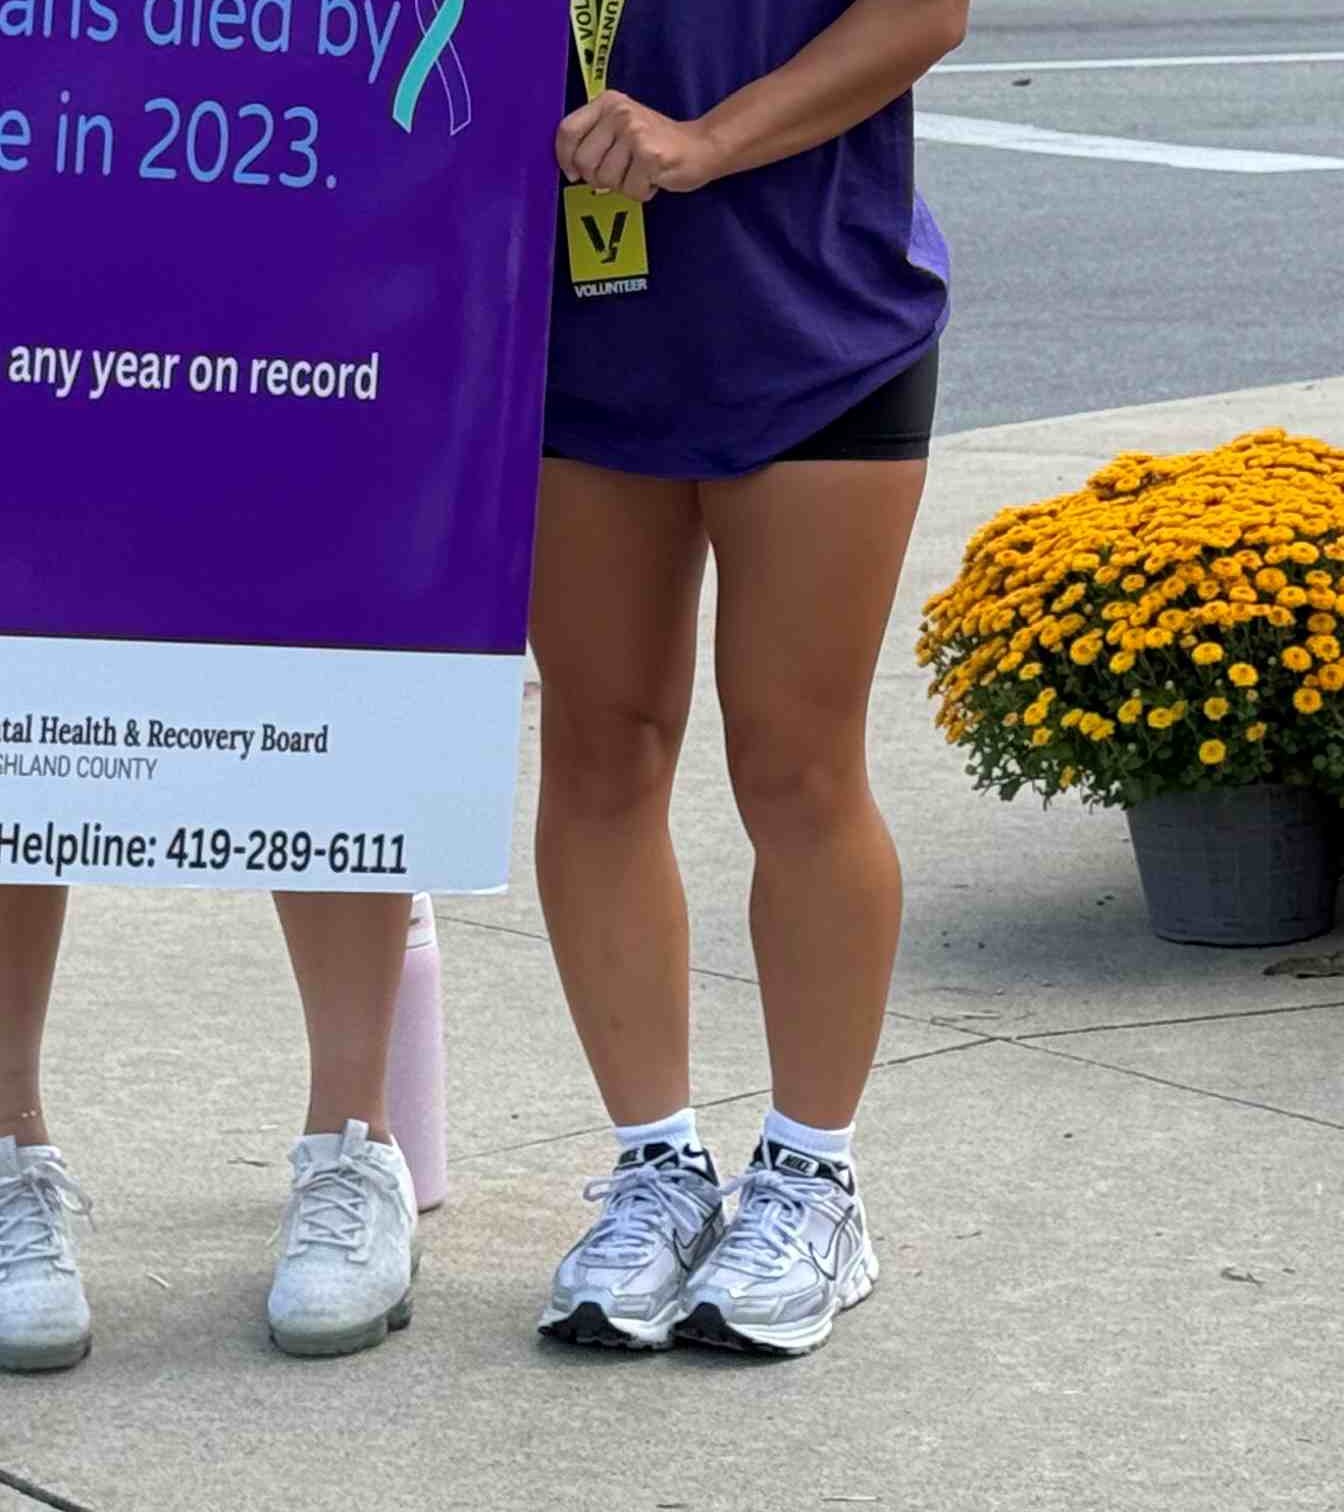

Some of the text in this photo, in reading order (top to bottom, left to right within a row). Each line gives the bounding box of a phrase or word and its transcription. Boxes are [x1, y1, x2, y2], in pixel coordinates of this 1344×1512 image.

[56, 90, 114, 176] in
[139, 97, 338, 190] 2023.
[574, 278, 648, 299] VOLUNTEER
[8, 345, 82, 398] any
[89, 350, 178, 399] year
[189, 355, 238, 393] on
[250, 352, 379, 400] record
[38, 715, 118, 747] Health
[123, 718, 142, 748] &
[146, 719, 256, 760] Recovery
[260, 723, 329, 755] Board
[76, 755, 158, 781] COUNTY
[165, 827, 408, 875] 419-289-6111
